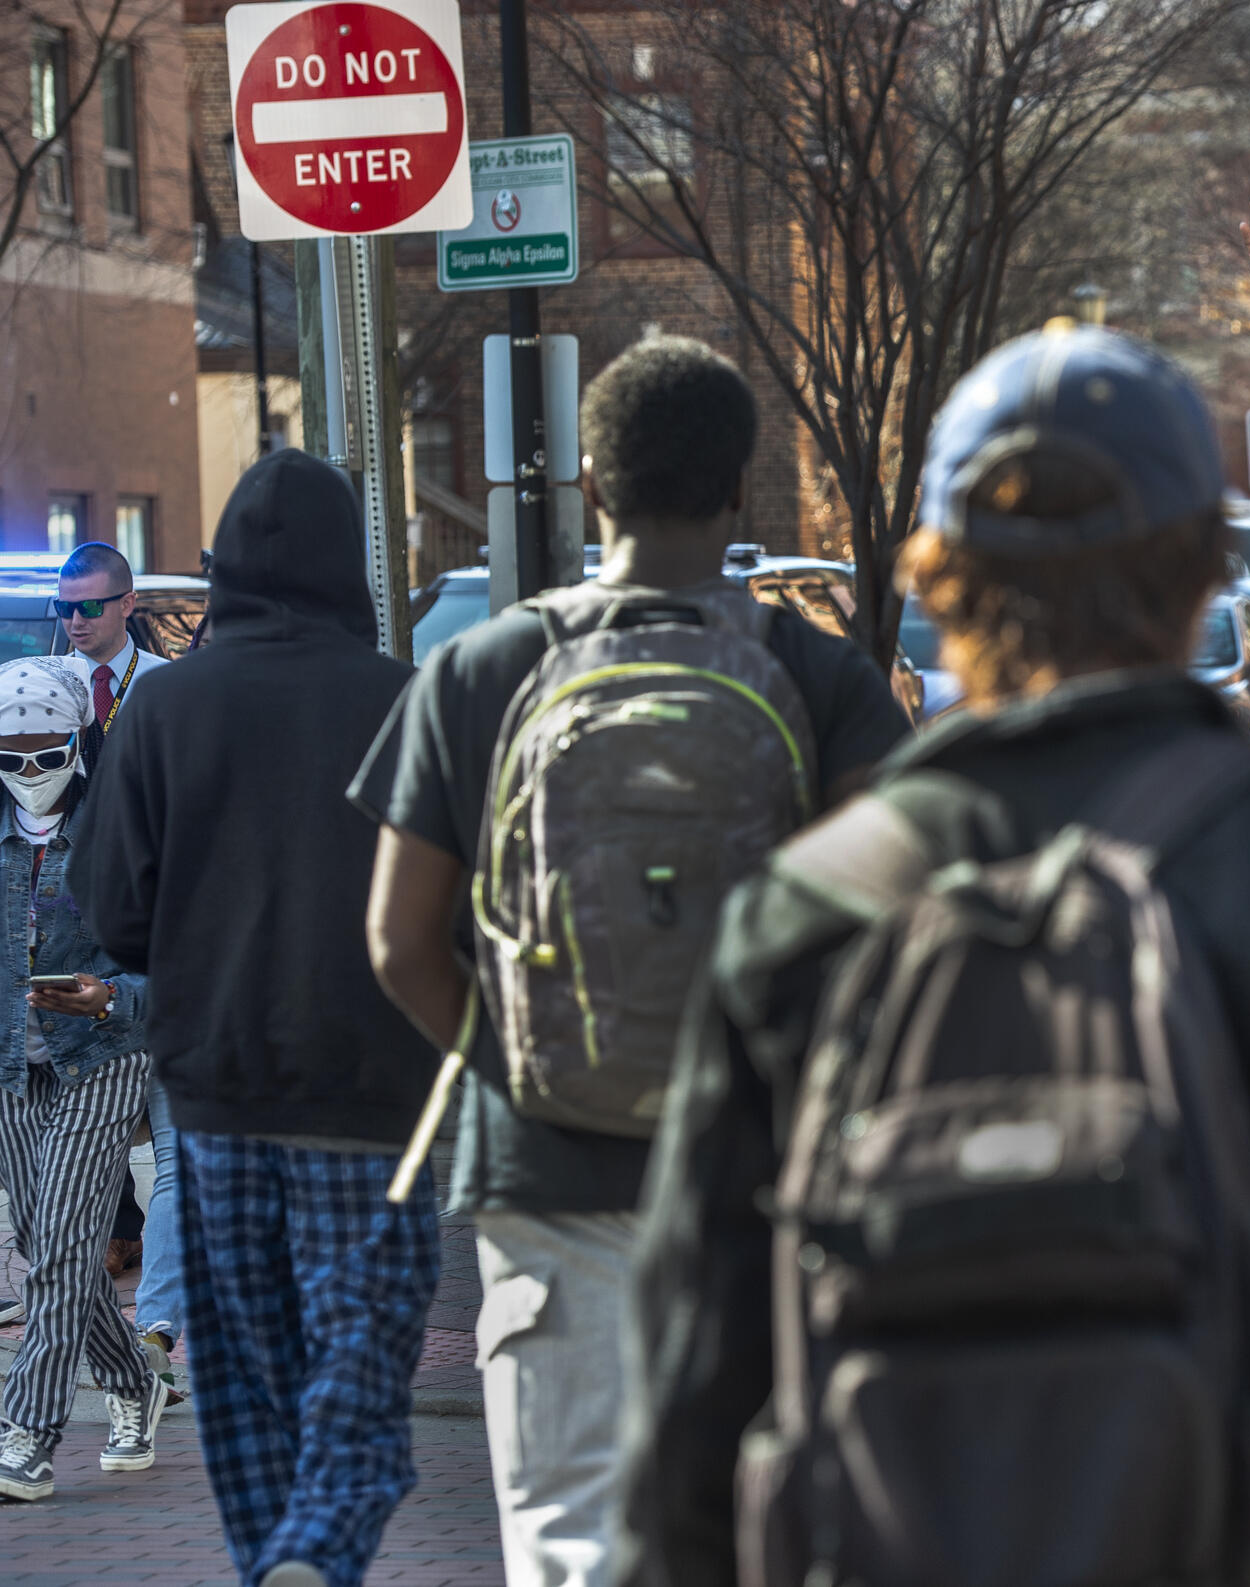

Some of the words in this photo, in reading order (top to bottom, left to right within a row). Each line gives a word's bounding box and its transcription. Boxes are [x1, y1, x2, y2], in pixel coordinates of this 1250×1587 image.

[275, 54, 326, 89] DO
[344, 48, 421, 85] NOT
[294, 148, 412, 186] ENTER
[450, 250, 487, 272] Sigma
[488, 245, 521, 268] Alpha
[523, 243, 565, 266] Epsilon
[109, 697, 121, 719] POLICE
